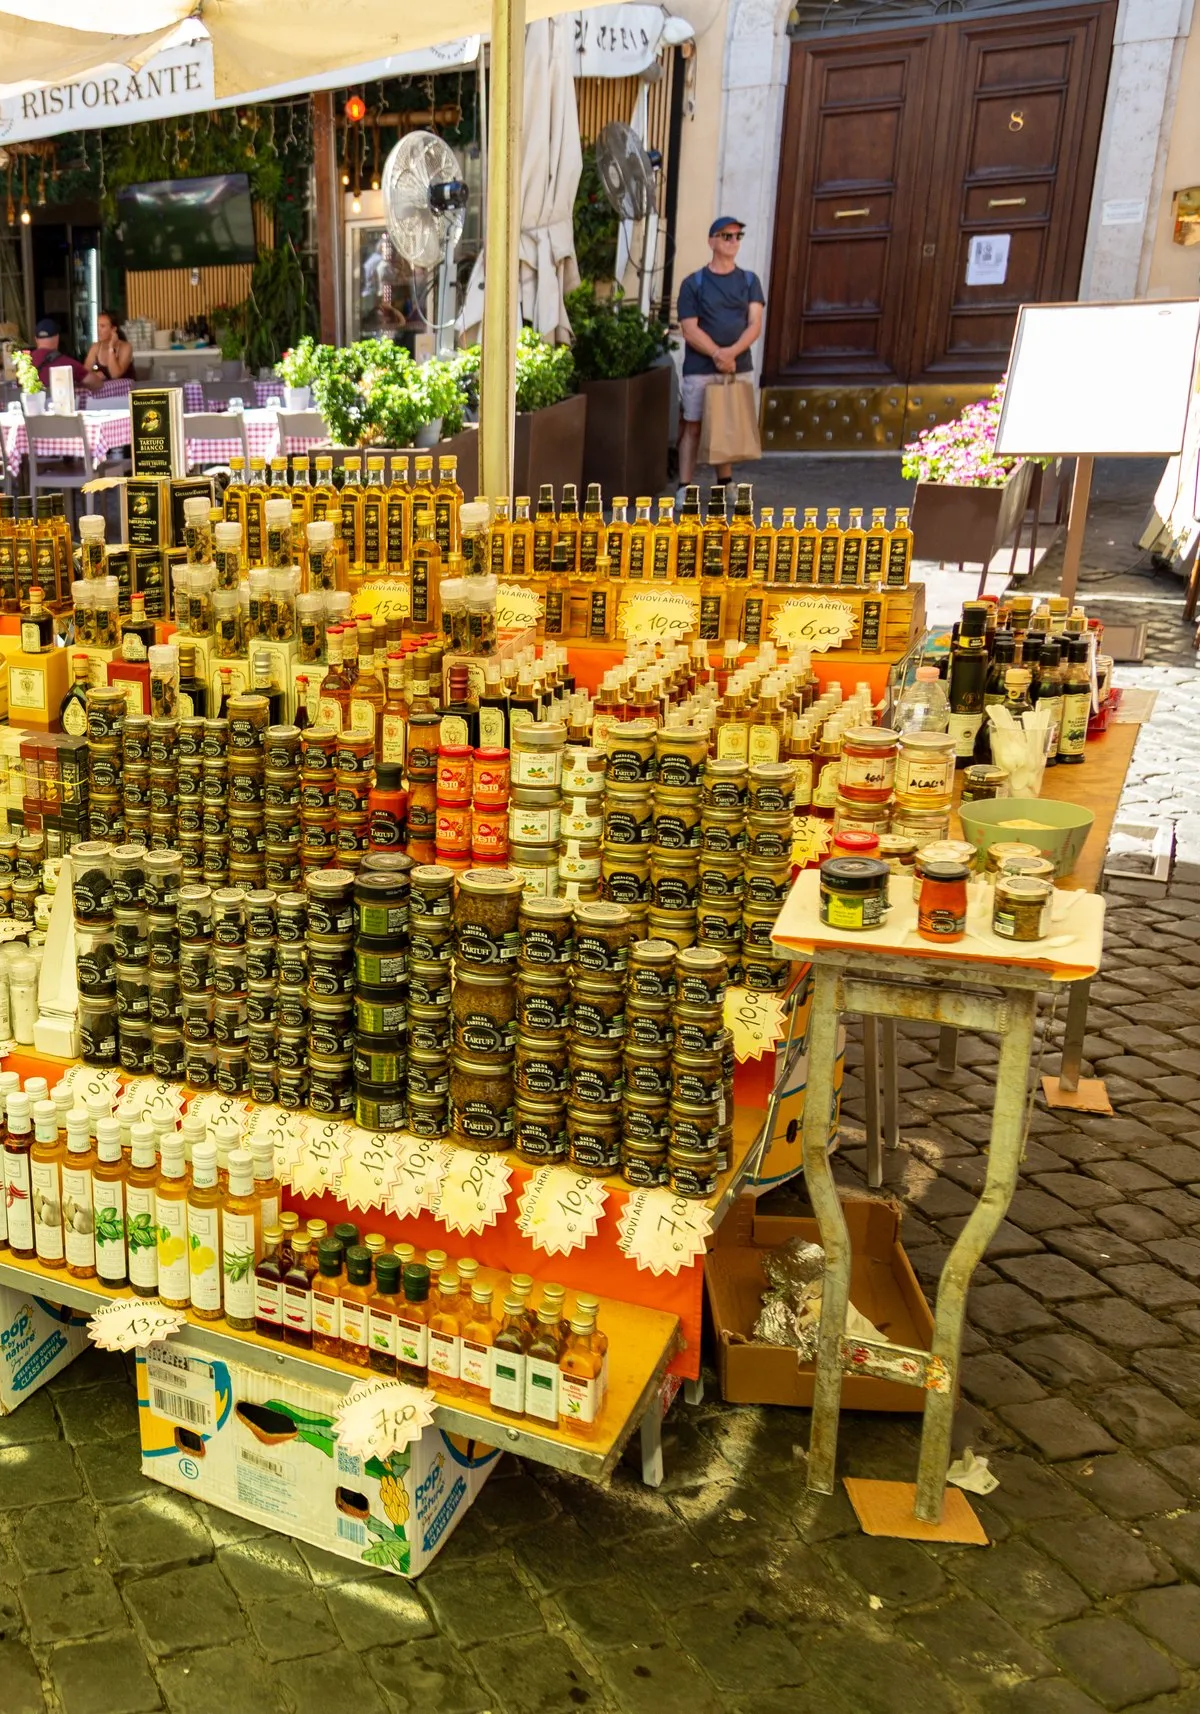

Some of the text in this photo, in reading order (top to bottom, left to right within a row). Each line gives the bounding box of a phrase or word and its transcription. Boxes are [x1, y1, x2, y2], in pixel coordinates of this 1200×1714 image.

[22, 63, 202, 119] RISTORANTE
[1008, 110, 1024, 132] 8
[361, 583, 386, 591] NUOVI
[633, 593, 662, 604] NUOVI
[785, 599, 814, 609] NUOVI
[373, 600, 409, 620] 15,00
[648, 613, 690, 635] 10,00
[800, 618, 841, 640] 6,00
[477, 783, 499, 792] PESTO
[473, 835, 497, 843] PESTO
[461, 942, 490, 956] TARTUFI
[527, 949, 550, 958] TARTUFI
[579, 955, 602, 965] TARTUFI
[636, 982, 658, 991] TARTUFI
[684, 990, 705, 1000] TARTUFI
[527, 1014, 550, 1024] TARTUFI
[575, 1020, 598, 1031] TARTUFI
[464, 1033, 495, 1045] TARTUFI
[527, 1079, 551, 1087] TARTUFI
[576, 1086, 599, 1097] TARTUFI
[680, 1087, 700, 1096] TARTUFI
[309, 1122, 340, 1162] 15,00
[522, 1139, 545, 1150] TARTUFI
[360, 1134, 393, 1173] 13,00
[403, 1140, 434, 1180] 10,00
[575, 1150, 598, 1162] TARTUFI
[461, 1152, 495, 1211] € 20,00
[628, 1170, 648, 1179] TARTUFI
[520, 1165, 553, 1230] NUOVI ARRIV
[557, 1177, 595, 1233] € 10,00
[622, 1188, 650, 1250] NUOVI ARRIV
[657, 1197, 697, 1252] € 7,00
[97, 1303, 132, 1316] NUOVI
[126, 1317, 177, 1336] 13,00
[5, 1332, 36, 1362] nature
[21, 1342, 61, 1386] CLASS EXTRA
[337, 1388, 372, 1410] NUOVI
[367, 1404, 417, 1445] € 7,00
[184, 1461, 193, 1476] E
[415, 1466, 440, 1509] pop
